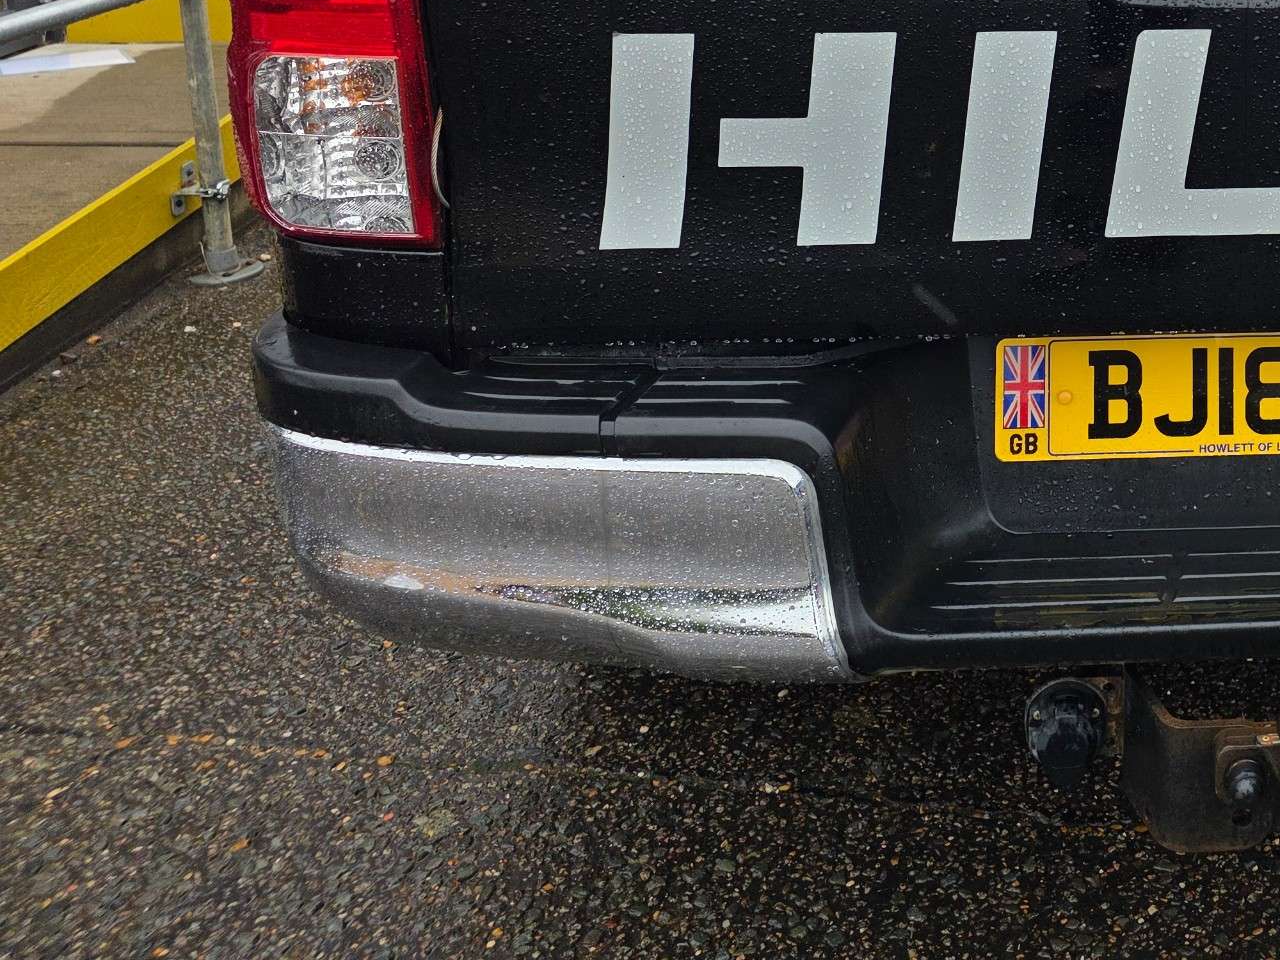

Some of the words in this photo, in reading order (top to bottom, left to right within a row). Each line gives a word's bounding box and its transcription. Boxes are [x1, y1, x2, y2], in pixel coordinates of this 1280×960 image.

[1008, 432, 1039, 455] GB
[1199, 442, 1254, 453] HOWLETT
[1257, 442, 1273, 452] OF
